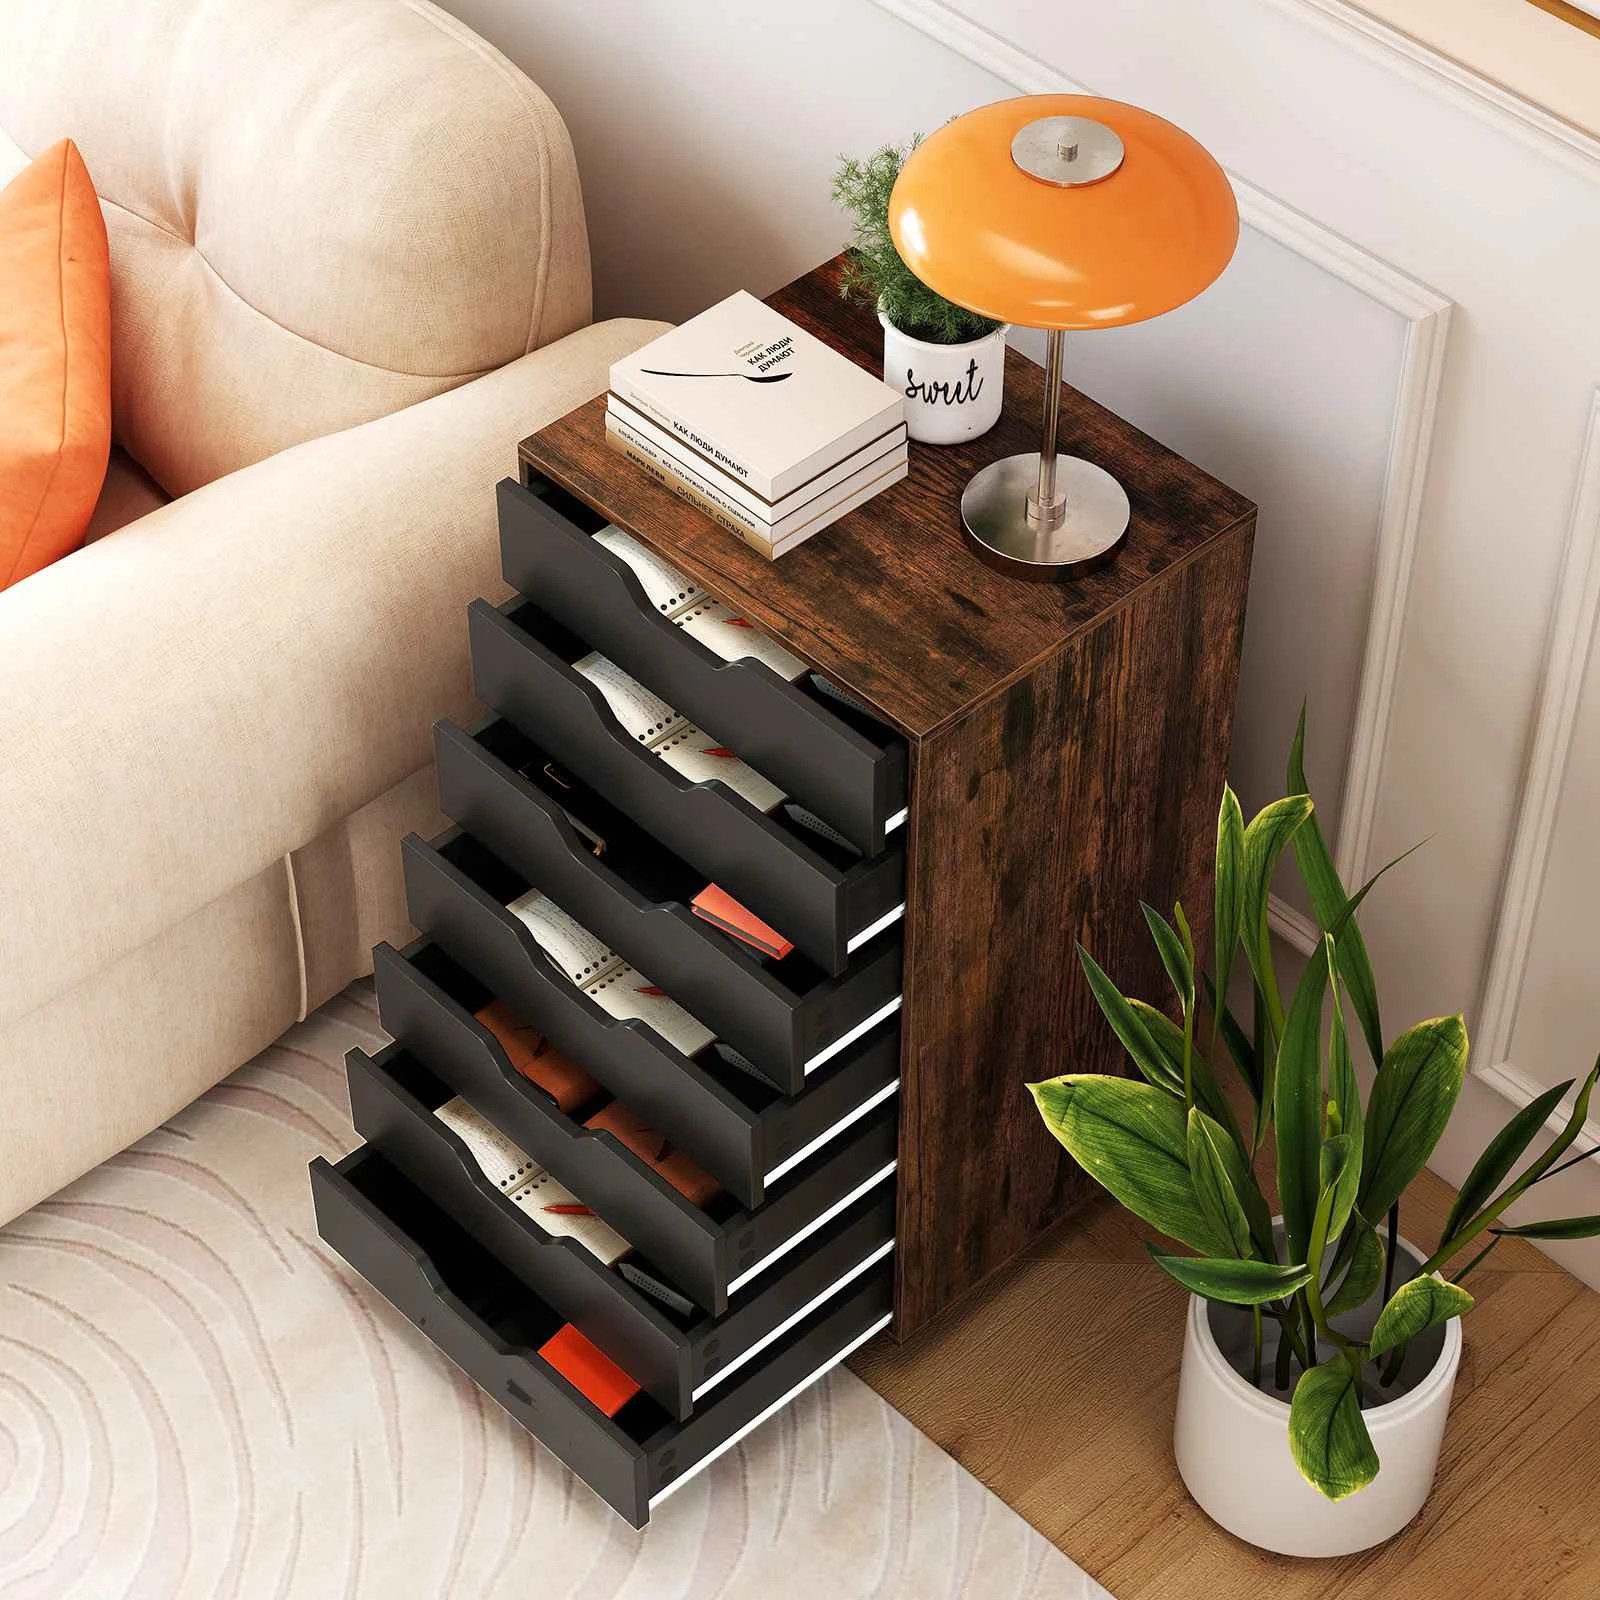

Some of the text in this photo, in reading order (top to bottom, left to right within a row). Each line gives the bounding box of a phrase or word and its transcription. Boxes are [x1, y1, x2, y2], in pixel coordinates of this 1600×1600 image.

[747, 352, 767, 365] КАК
[765, 336, 793, 355] ЛЮДИ
[758, 347, 795, 373] ДУМАЮТ
[905, 358, 984, 406] sweet
[673, 421, 749, 478] КАК ЛЮДИ ДУМАЮТ
[646, 462, 666, 481] ЛЕВИ
[676, 486, 714, 515] СИЛЬНЕЕ
[716, 513, 745, 540] СТРАХА
